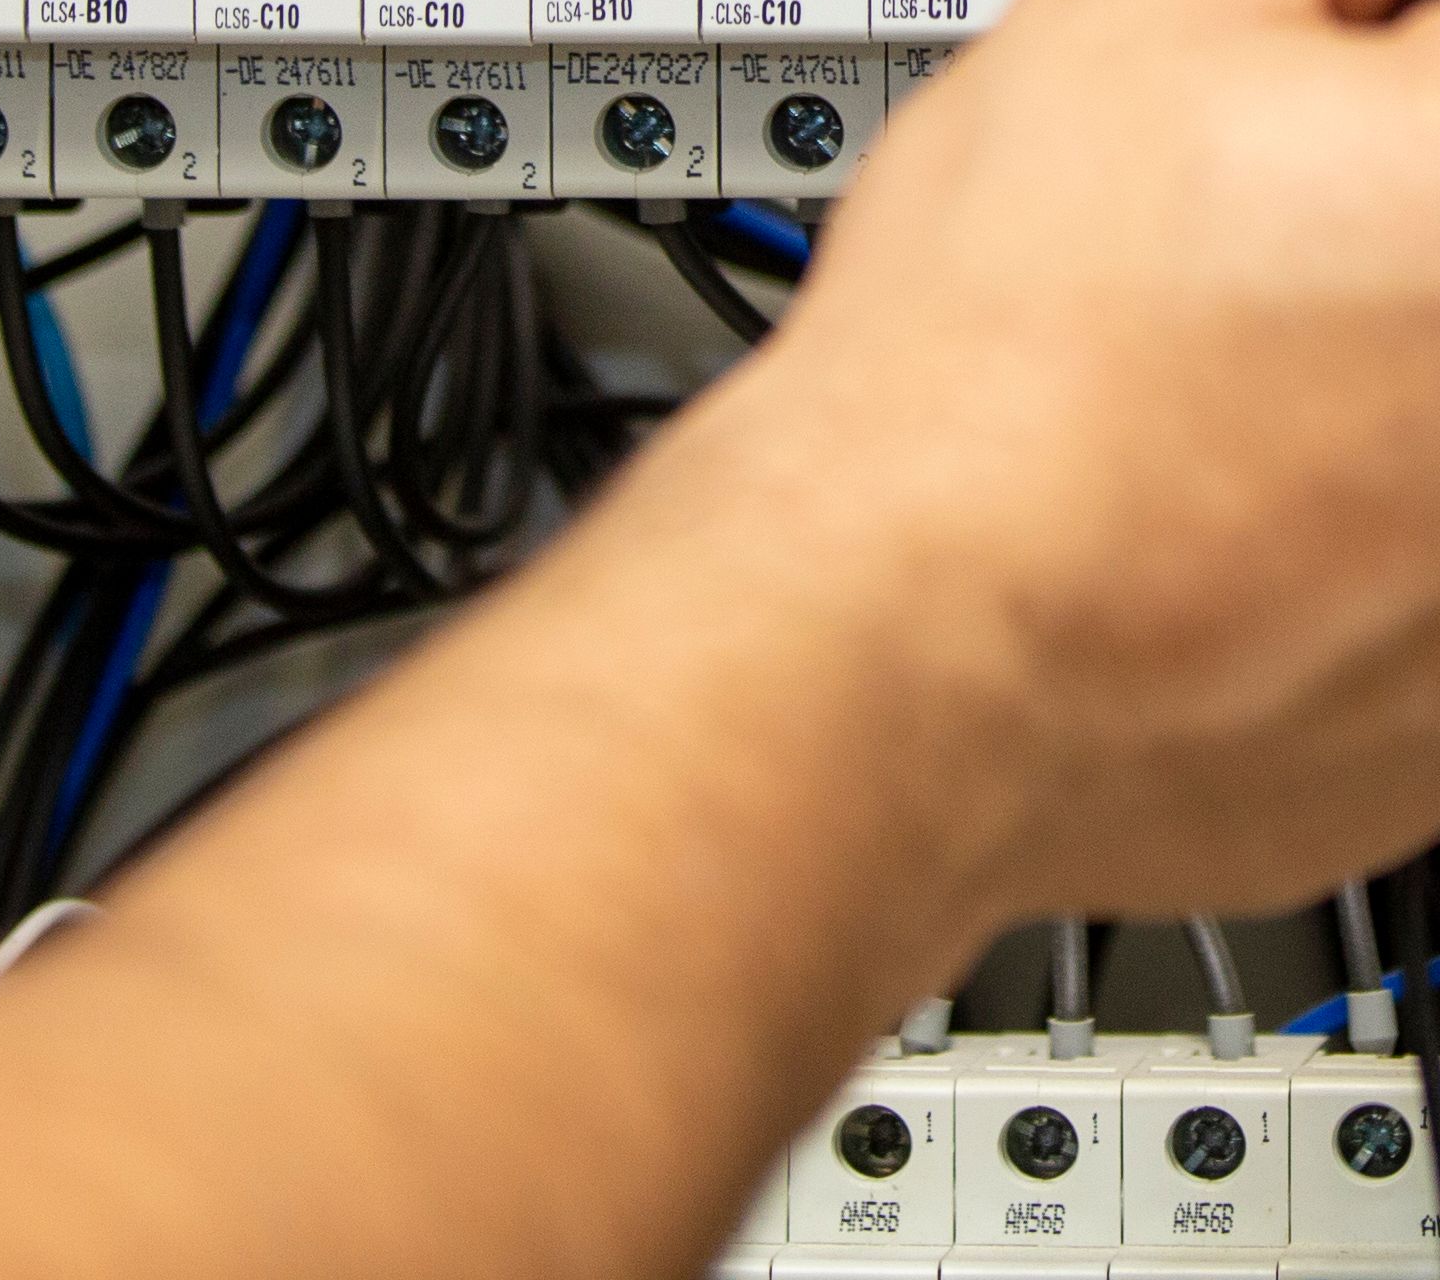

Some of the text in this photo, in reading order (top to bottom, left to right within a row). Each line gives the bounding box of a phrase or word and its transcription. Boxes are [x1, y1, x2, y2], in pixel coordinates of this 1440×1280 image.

[215, 3, 299, 30] CLS6-C10
[380, 1, 464, 28] CLS6-C10
[716, 0, 801, 25] CLS6-C10
[109, 50, 188, 80] 247827
[276, 57, 355, 86] 247611
[446, 60, 526, 90] 247611
[780, 55, 860, 85] 247611
[21, 149, 36, 178] 2
[182, 151, 196, 180] 2
[352, 158, 366, 186] 2
[522, 162, 537, 190] 2
[686, 145, 705, 178] 2
[926, 1111, 933, 1143] 1
[1092, 1113, 1099, 1144] 1
[1262, 1112, 1270, 1143] 1
